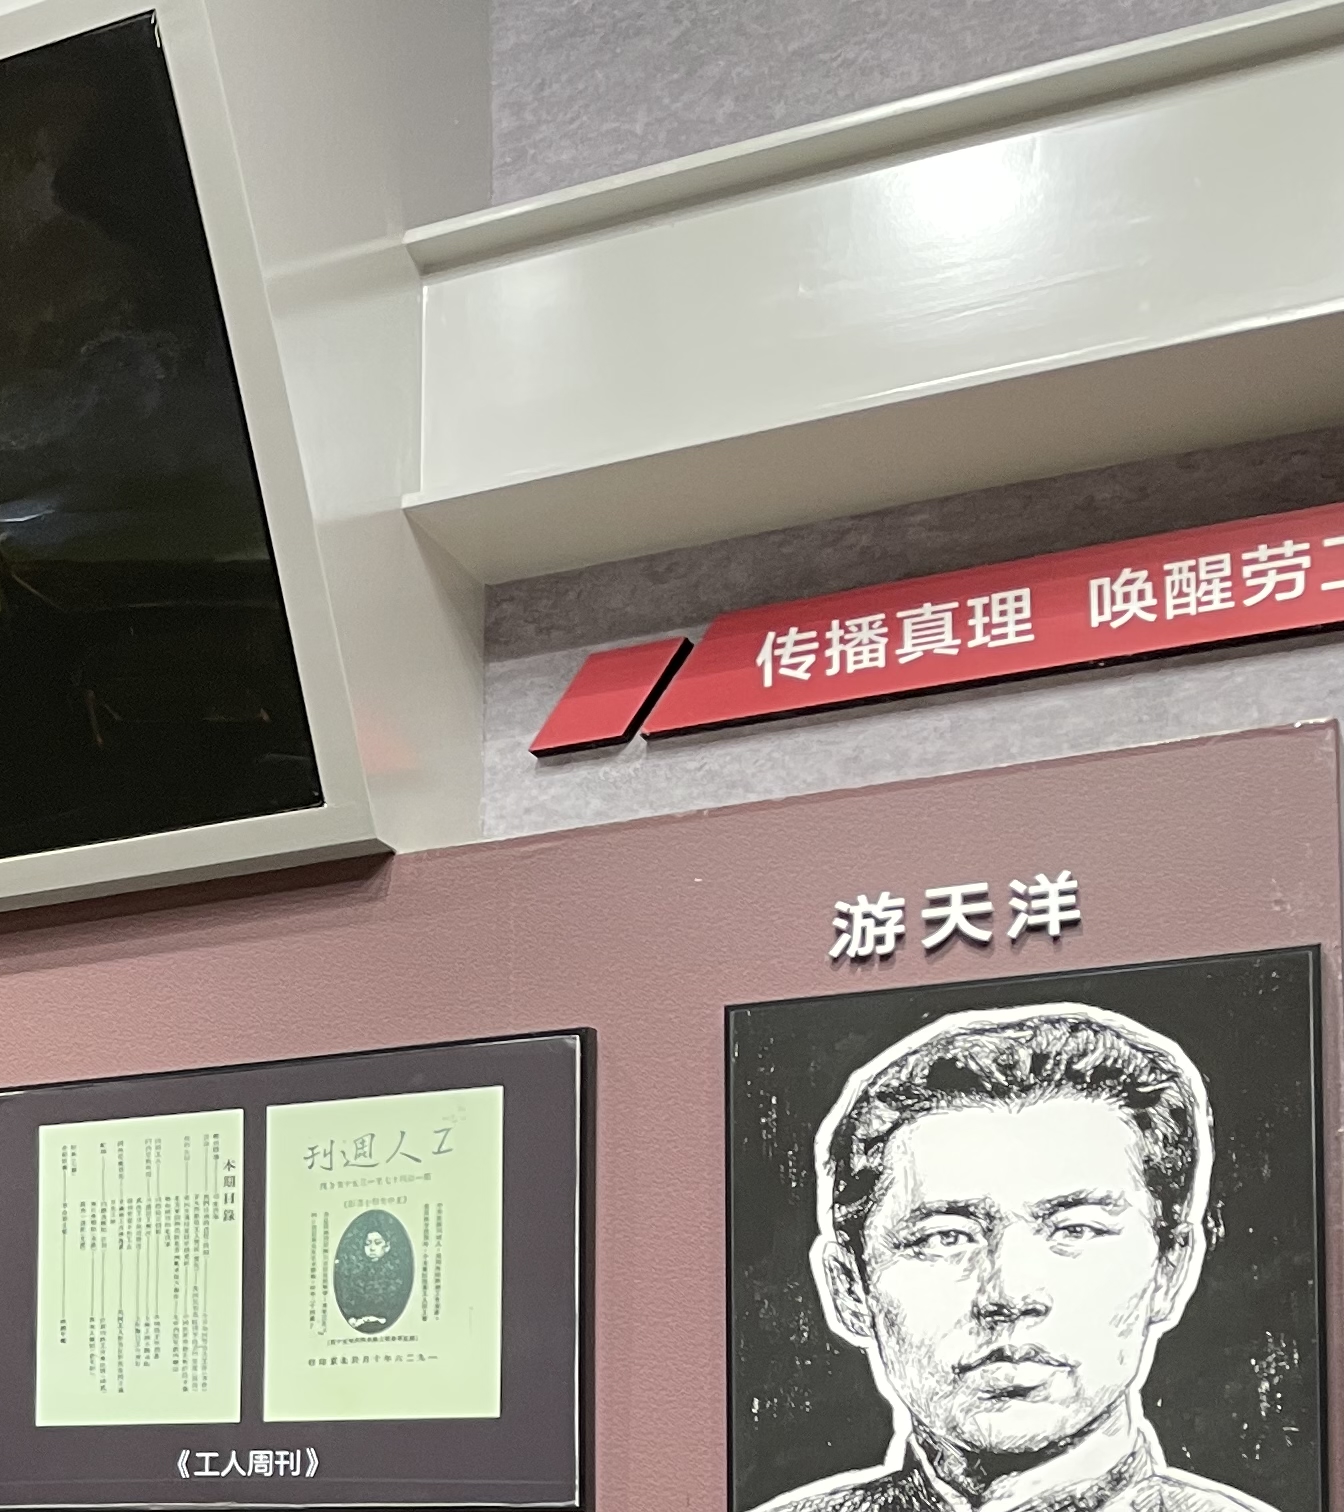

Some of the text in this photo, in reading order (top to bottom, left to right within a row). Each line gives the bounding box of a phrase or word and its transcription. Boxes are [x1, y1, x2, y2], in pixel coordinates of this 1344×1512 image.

[756, 588, 1034, 688] 传播真理
[828, 870, 1083, 960] 游天洋
[177, 1447, 320, 1479] 《工人周刊》
